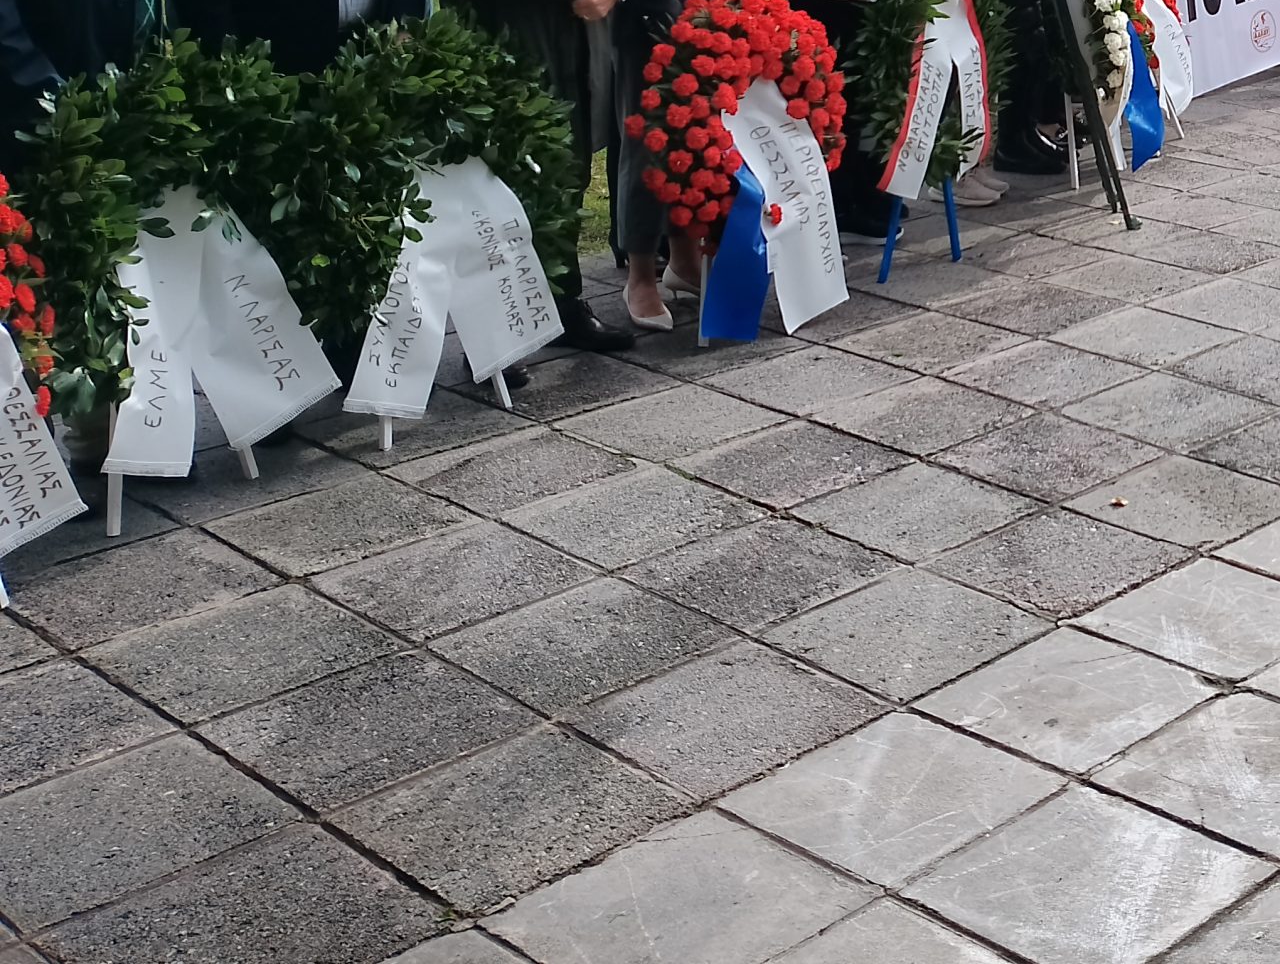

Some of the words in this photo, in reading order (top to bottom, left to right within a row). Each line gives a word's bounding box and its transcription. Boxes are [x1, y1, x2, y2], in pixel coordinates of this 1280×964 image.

[898, 60, 934, 172] ΝΟΜΑΡΧΙΑΚΗ
[915, 68, 944, 163] ΕΠΙΤΡΟΠΗ
[964, 73, 976, 131] ΛΑΡΙΣΑ
[750, 125, 811, 232] ΘΕΣΣΑΛΙΑΣ
[779, 121, 836, 275] ΠΕΡΙΦΕΡΕΙΑΡΧΗΣ
[514, 254, 550, 331] ΛΑΡΙΣΑΣ
[144, 349, 168, 428] ΕΛΜΕ
[239, 301, 300, 392] ΛΑΡΙΣΑΣ
